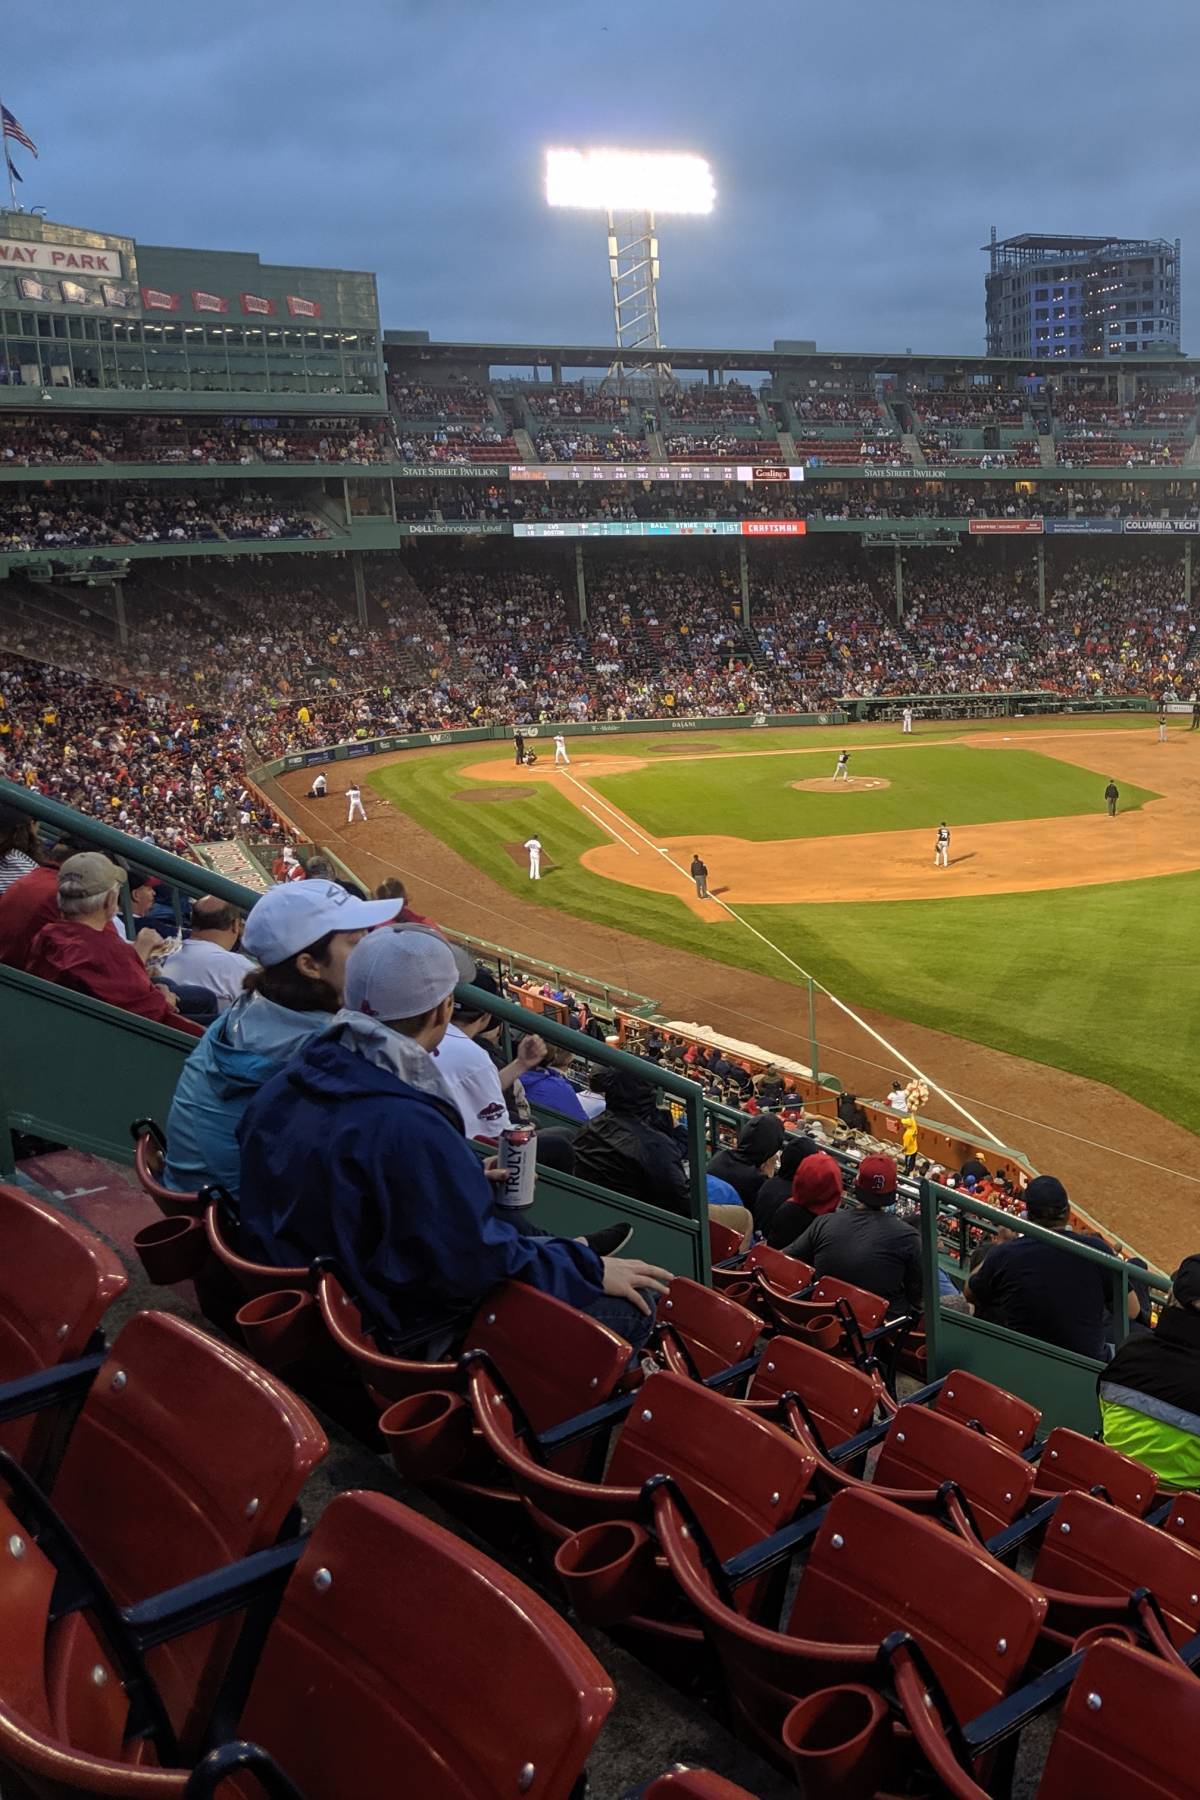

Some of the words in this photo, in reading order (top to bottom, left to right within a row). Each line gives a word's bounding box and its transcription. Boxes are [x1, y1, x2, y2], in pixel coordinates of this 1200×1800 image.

[51, 251, 109, 271] PARK
[402, 467, 426, 477] STATE
[428, 467, 459, 477] STREET
[460, 467, 498, 477] PAVILION
[864, 469, 885, 477] STATE
[886, 469, 911, 477] STREET
[912, 469, 946, 477] PAVILION
[482, 525, 502, 533] Level
[1126, 521, 1171, 529] COLUMBIA
[672, 721, 696, 729] DASANI
[504, 1147, 522, 1195] TRULY
[872, 1174, 886, 1190] B
